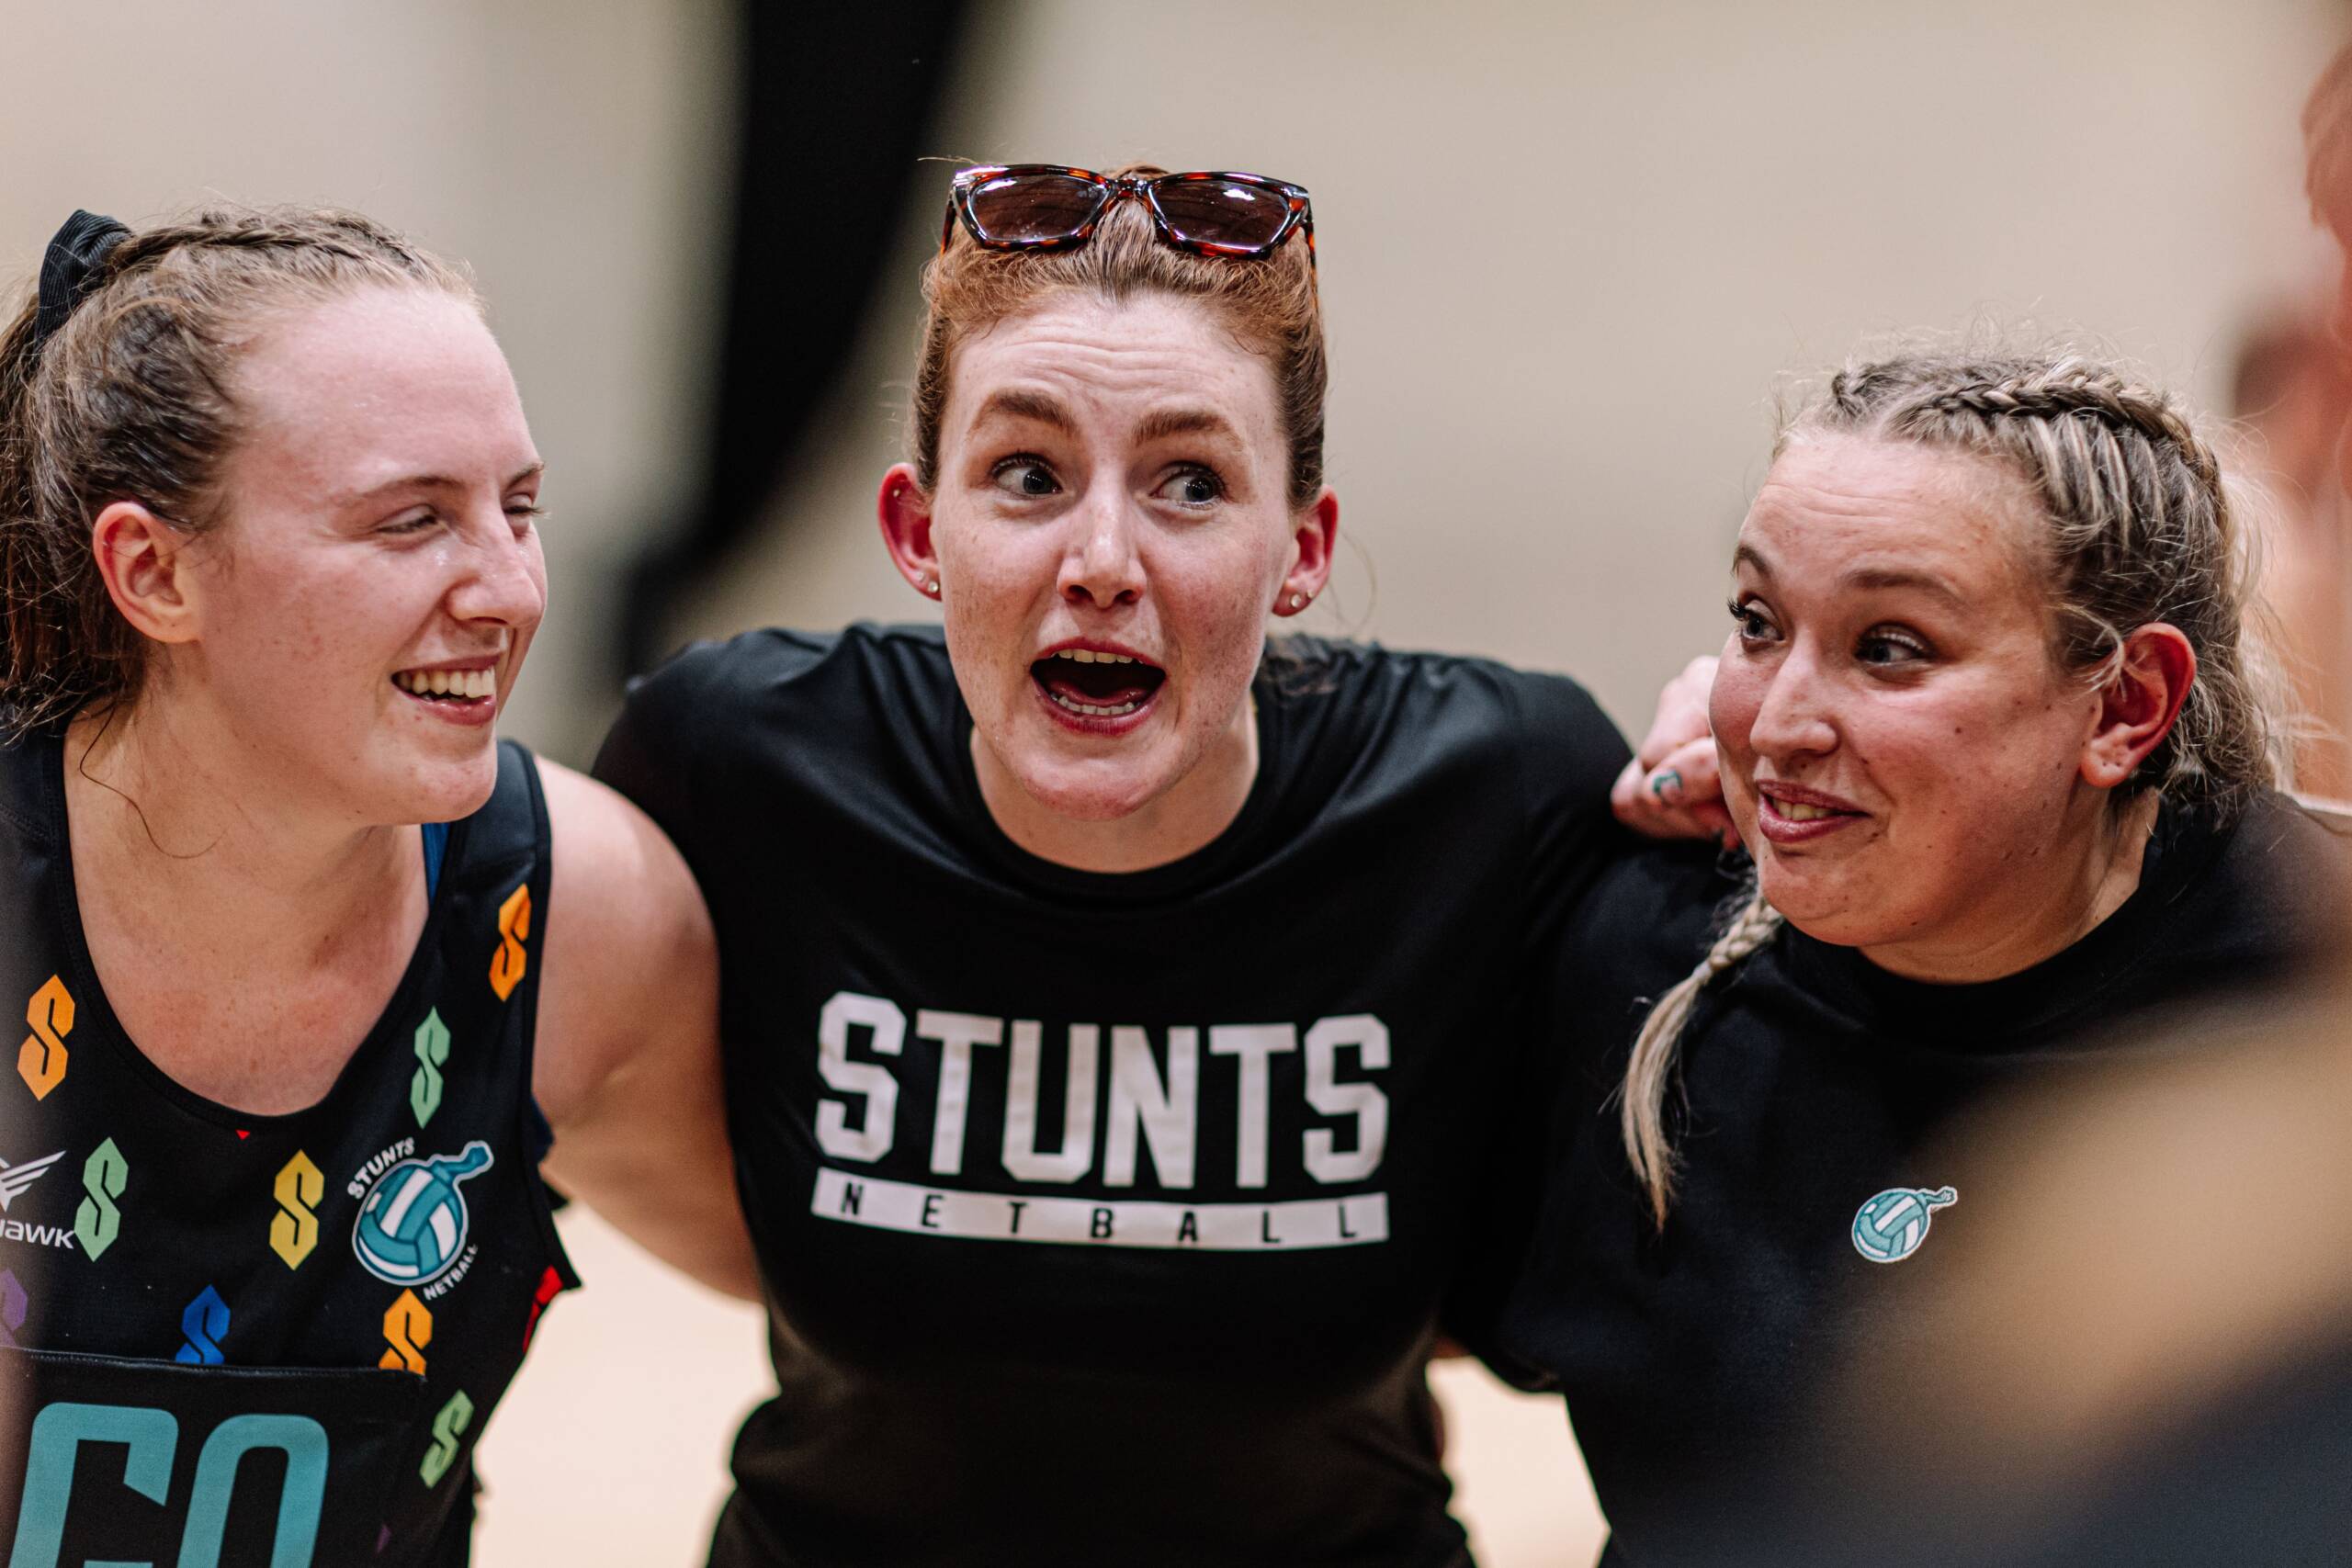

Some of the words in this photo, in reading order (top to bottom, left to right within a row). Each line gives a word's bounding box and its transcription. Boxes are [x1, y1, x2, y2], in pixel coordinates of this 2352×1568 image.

[815, 991, 1391, 1189] STUNTS
[346, 1137, 415, 1200] STUNTS
[840, 1180, 1358, 1245] NETBALL
[423, 1243, 479, 1301] NETBALL
